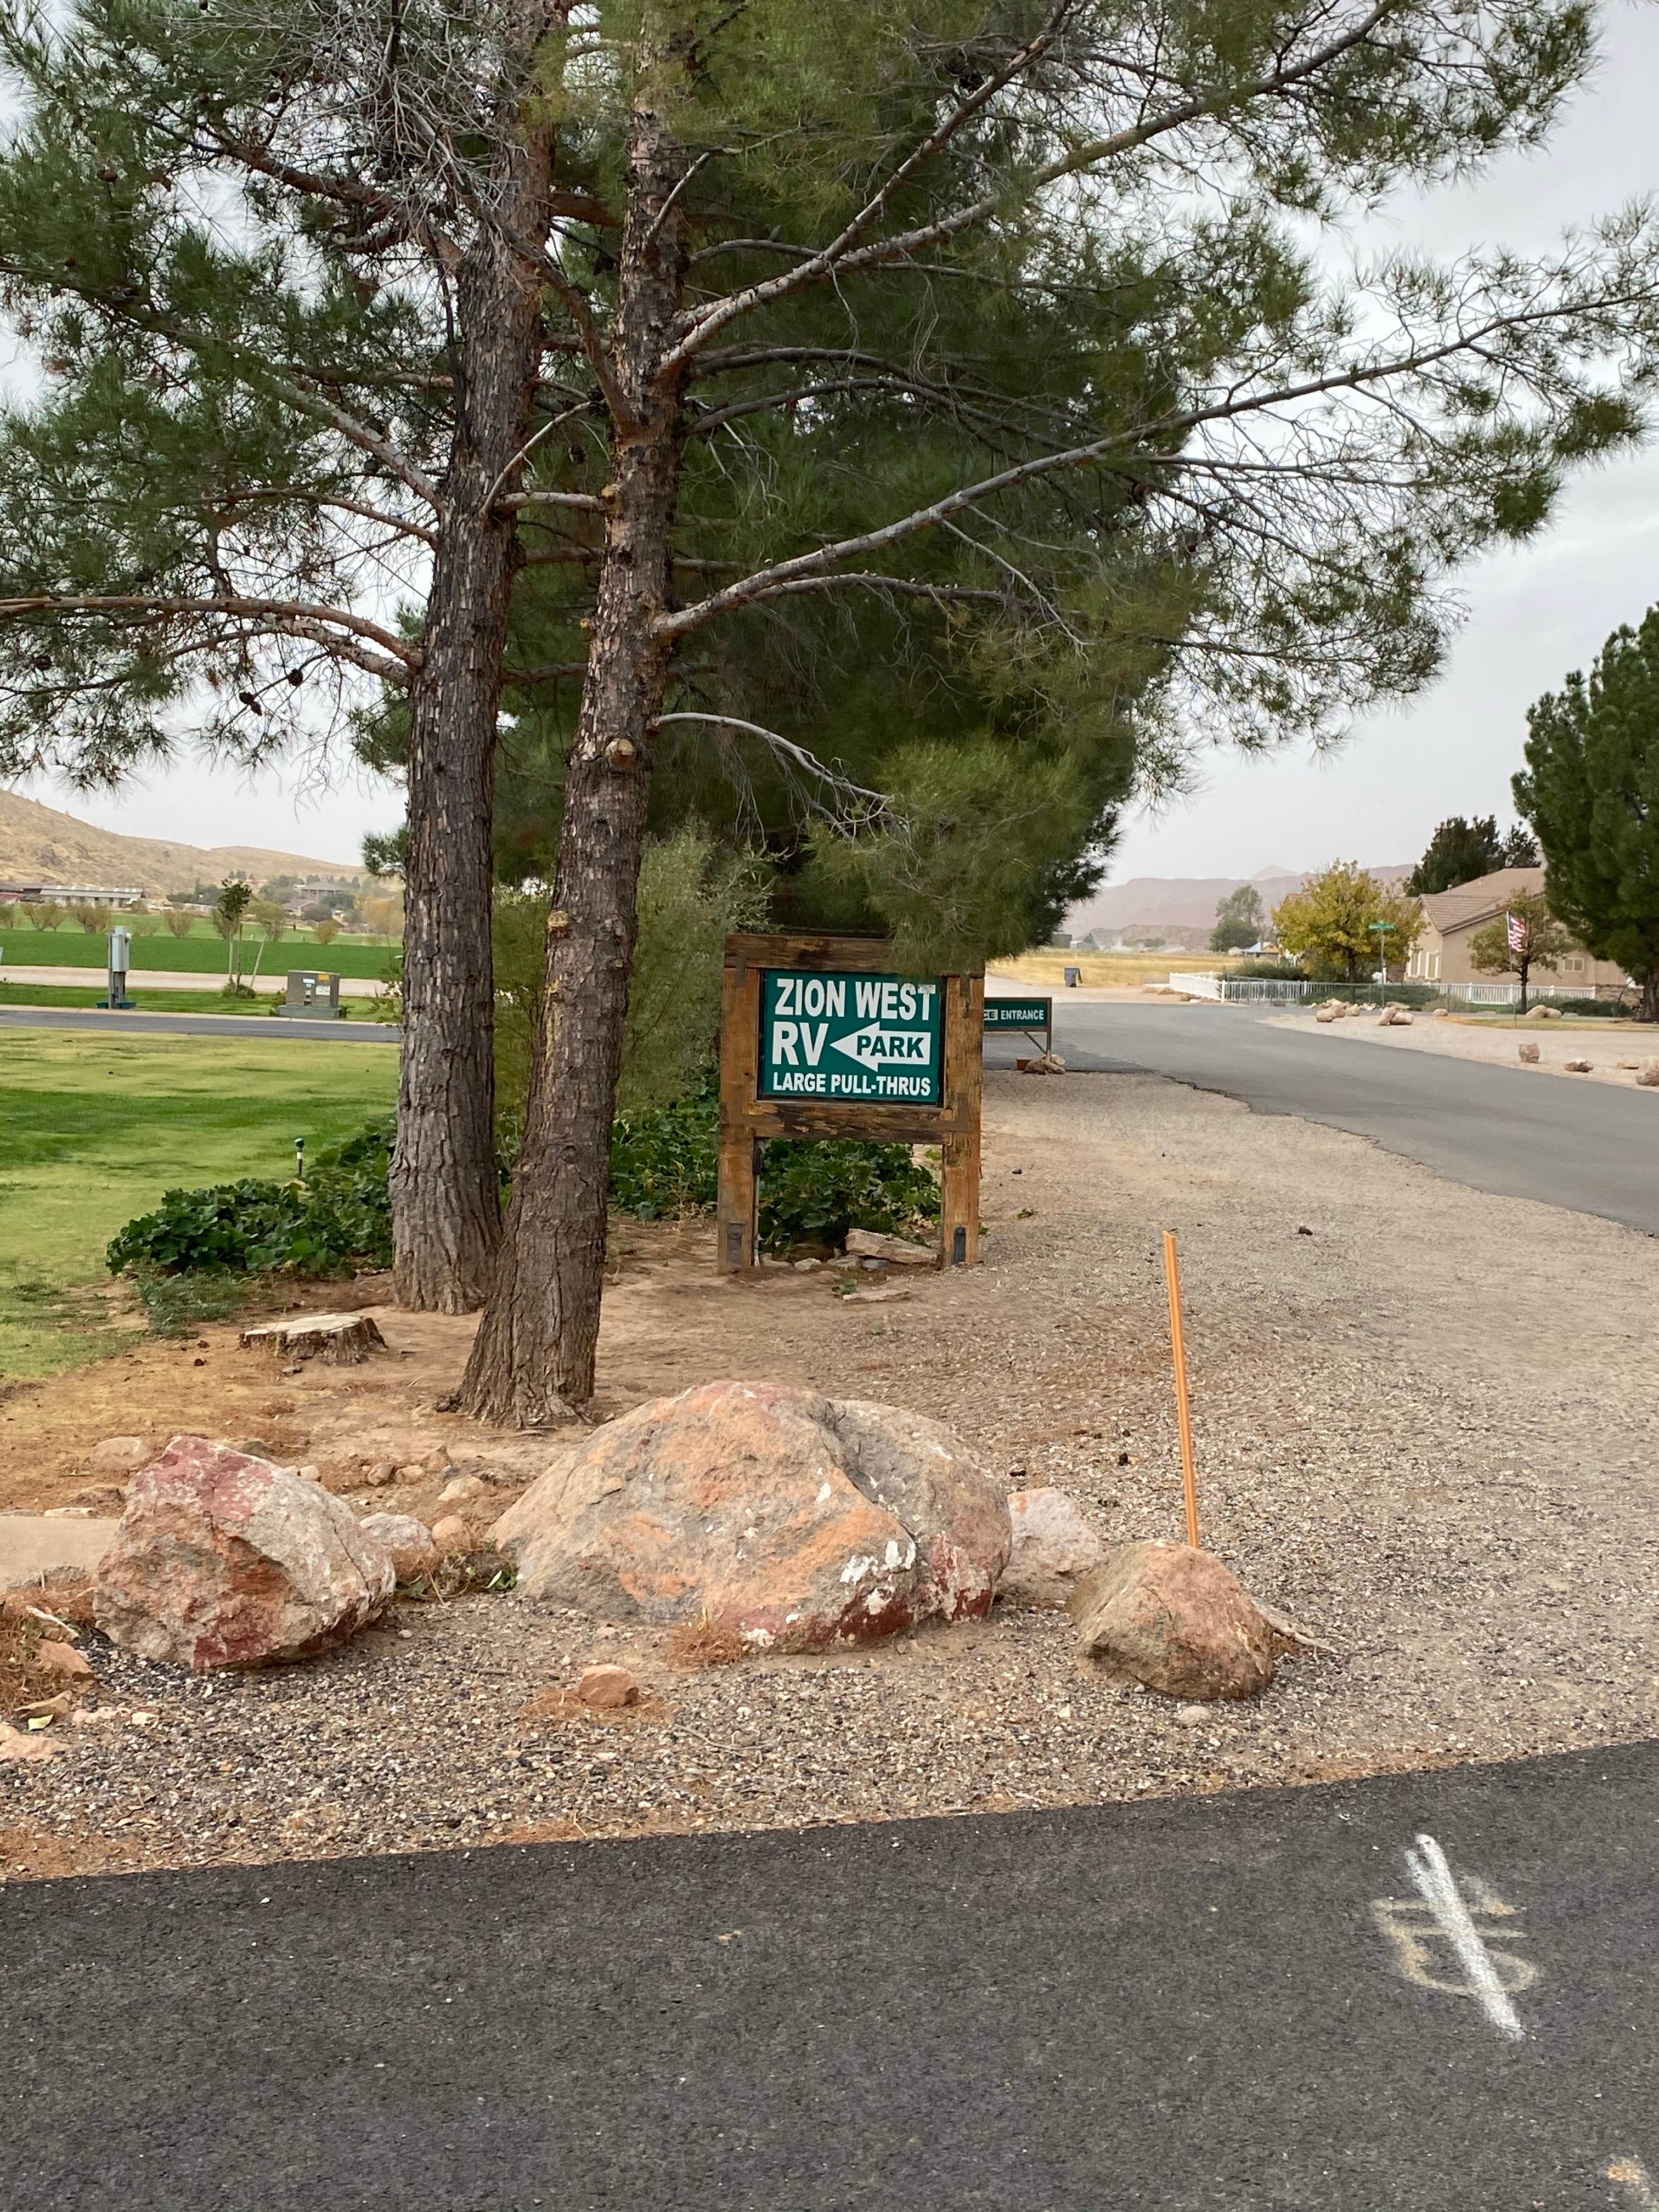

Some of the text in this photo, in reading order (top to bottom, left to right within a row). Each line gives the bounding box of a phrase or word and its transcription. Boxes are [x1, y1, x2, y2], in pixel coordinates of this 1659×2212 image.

[775, 978, 936, 1020] ZION WEST
[1001, 1009, 1044, 1020] ENTRANCE
[772, 1021, 925, 1066] RV PARK
[773, 1071, 931, 1096] LARGE PULL-THRUS
